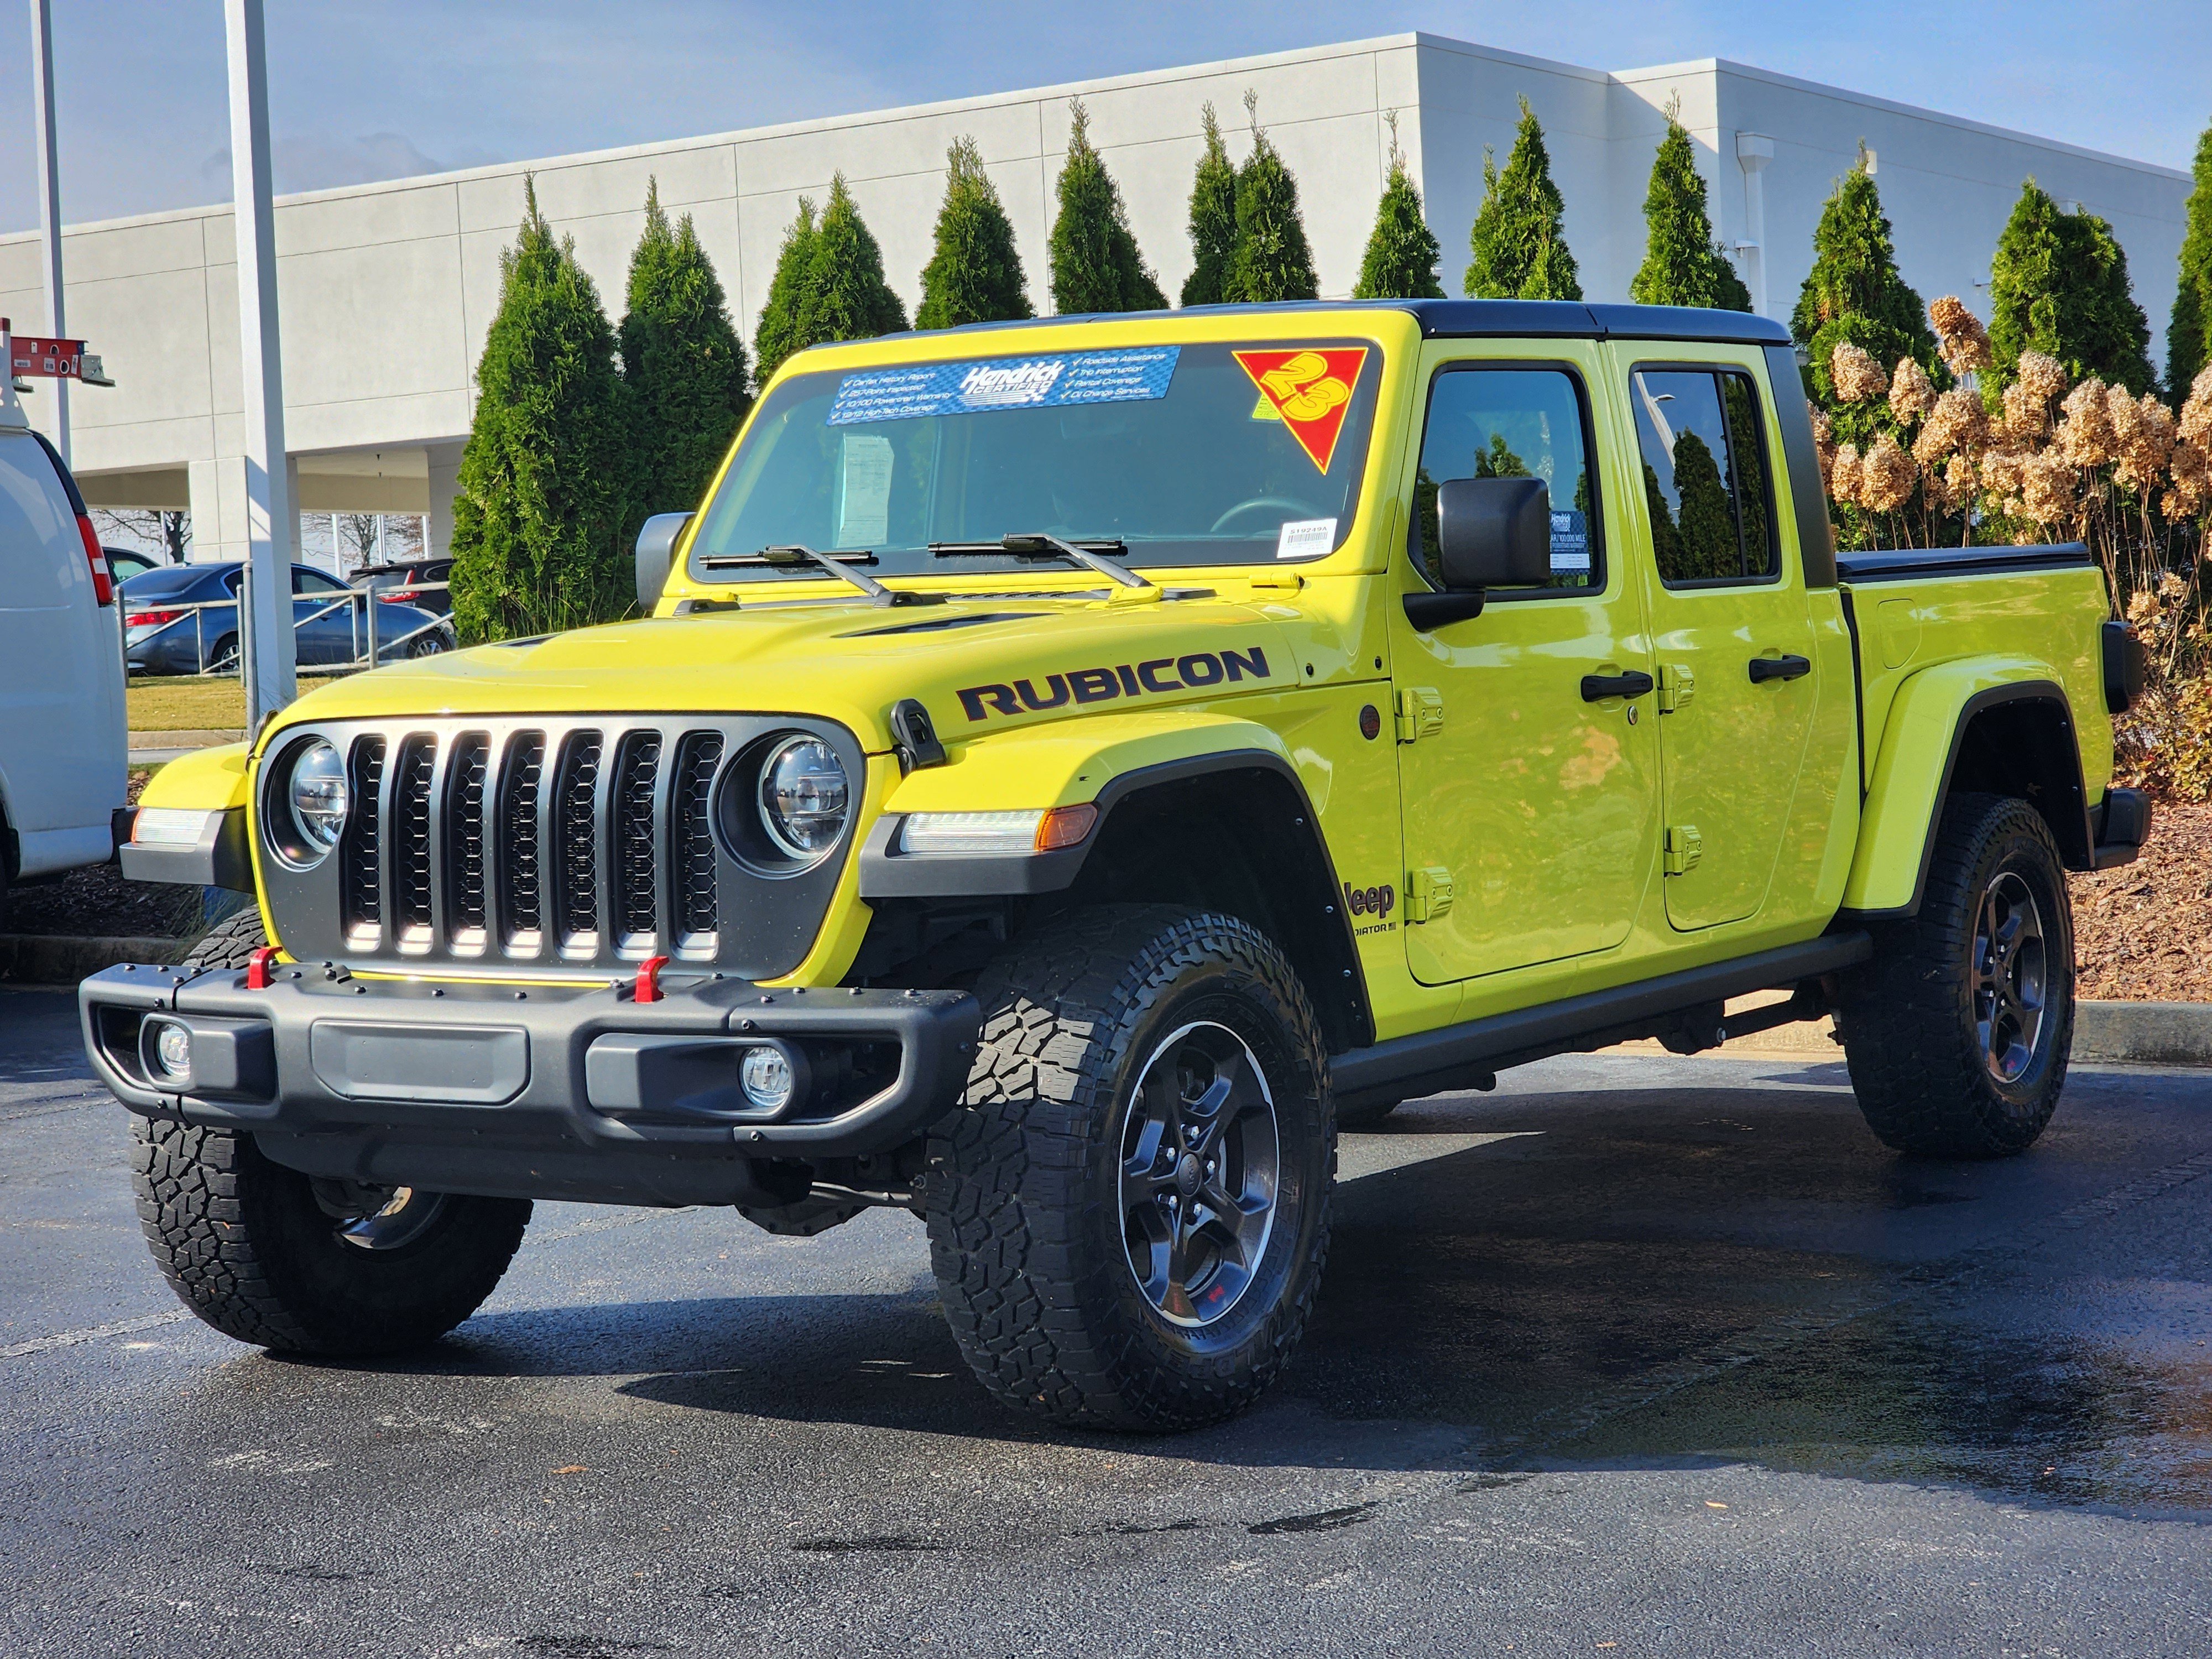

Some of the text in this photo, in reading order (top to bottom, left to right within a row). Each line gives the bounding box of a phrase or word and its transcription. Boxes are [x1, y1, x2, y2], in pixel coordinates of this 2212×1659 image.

[1082, 353, 1166, 365] Roadside Assistance
[959, 360, 1067, 395] Hendrick
[1079, 369, 1095, 377] Trip
[852, 378, 878, 387] Carfax
[879, 375, 907, 384] History
[972, 380, 1053, 394] CERTIFIED
[1260, 351, 1350, 421] 23
[1083, 389, 1114, 398] Change
[1114, 388, 1151, 396] Services
[846, 399, 873, 408] 10/100
[873, 397, 915, 405] Powertrain
[864, 407, 899, 416] High-Tech
[1551, 513, 1571, 526] Hendrick
[956, 647, 1270, 722] RUBICON
[1355, 924, 1387, 936] DIATOR
